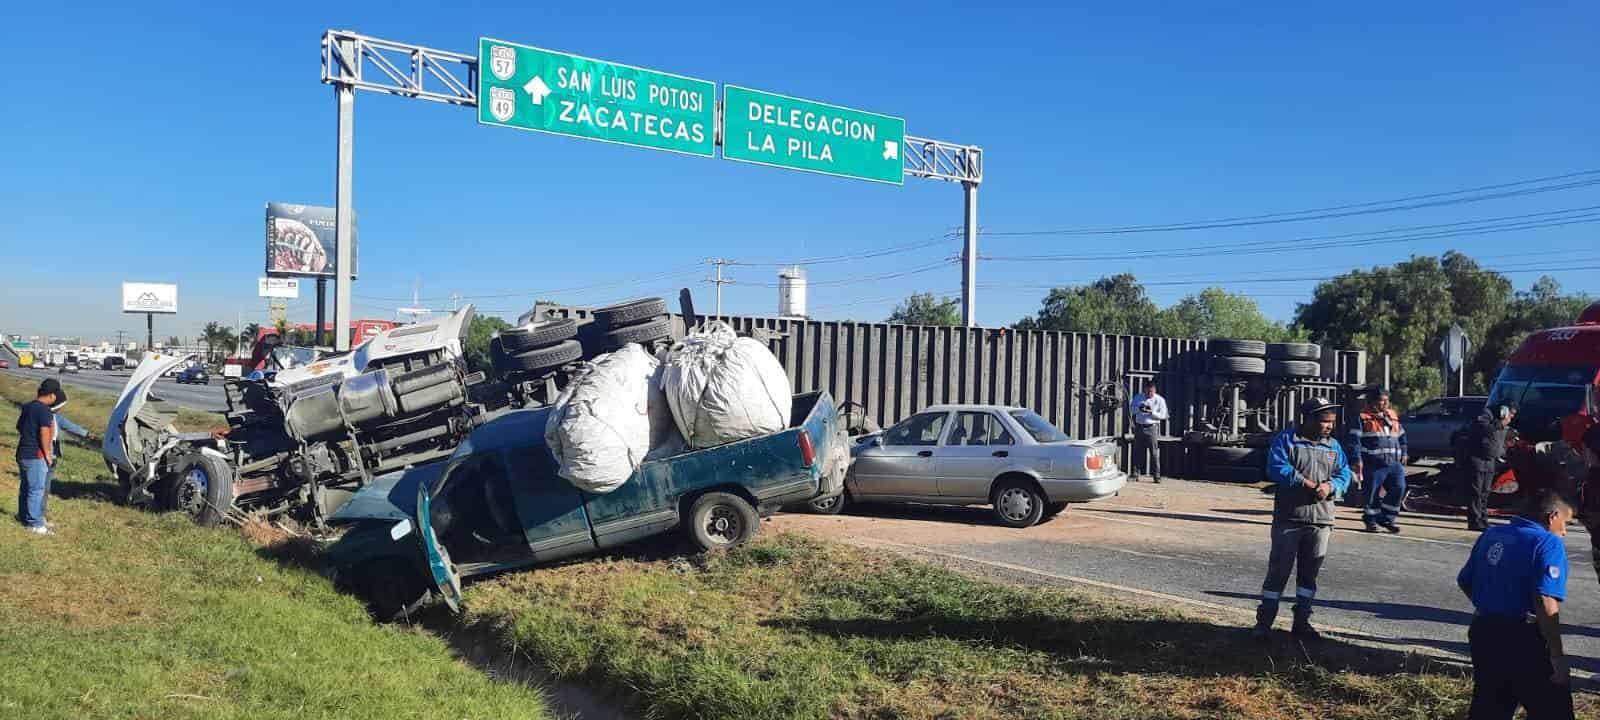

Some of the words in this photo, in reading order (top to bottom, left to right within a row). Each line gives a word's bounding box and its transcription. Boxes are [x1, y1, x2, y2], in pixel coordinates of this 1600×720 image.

[496, 59, 510, 74] 57
[557, 67, 592, 92] SAN
[601, 75, 636, 101] LUIS
[649, 84, 703, 113] POTOSI
[495, 101, 510, 115] 49
[559, 100, 705, 143] ZACATECAS
[748, 101, 875, 141] DELEGACION
[748, 131, 776, 153] LA
[788, 137, 833, 162] PILA
